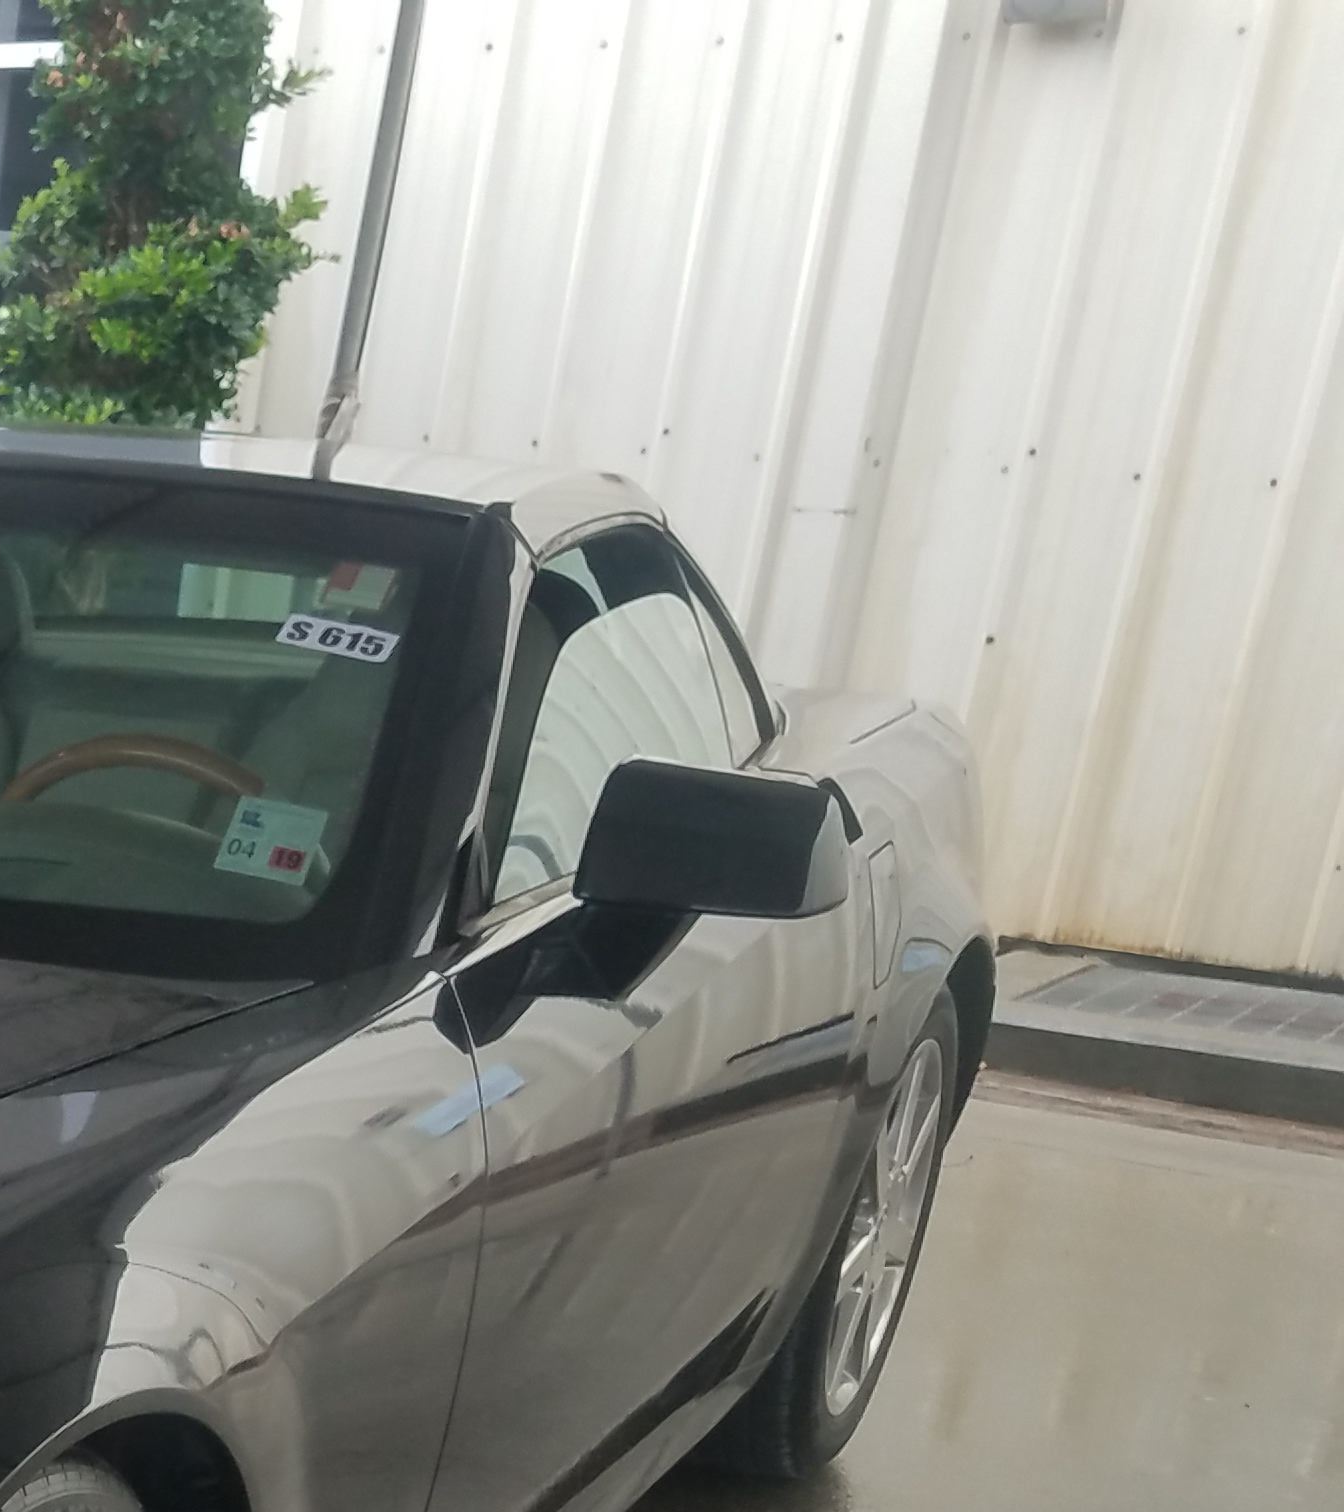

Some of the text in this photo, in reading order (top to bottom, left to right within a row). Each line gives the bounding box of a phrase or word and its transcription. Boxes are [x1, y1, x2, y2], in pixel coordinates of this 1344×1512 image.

[286, 621, 386, 656] S 615
[228, 838, 256, 859] 04
